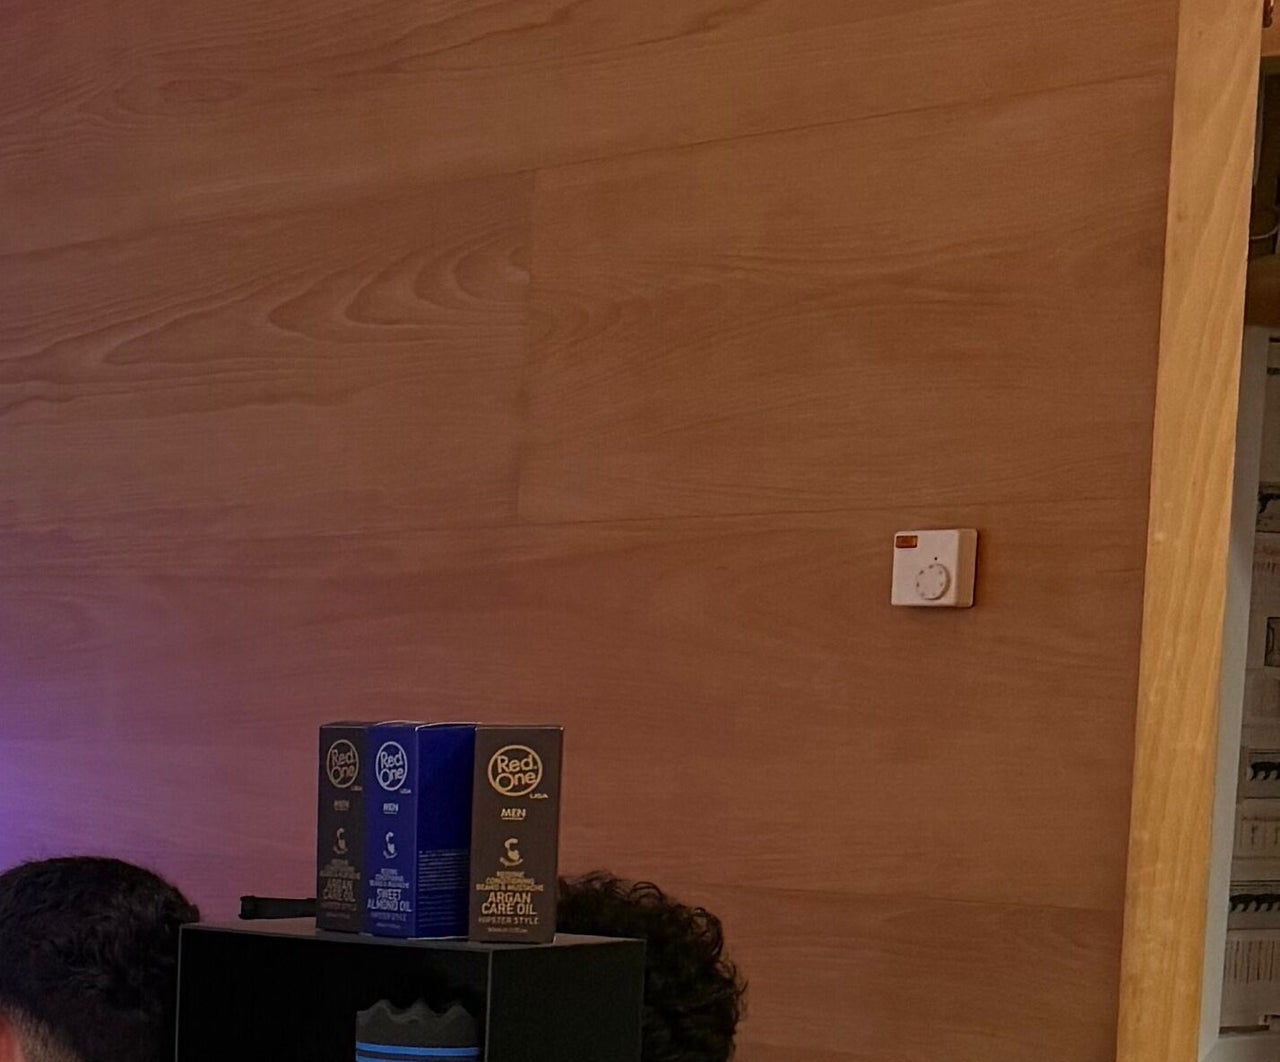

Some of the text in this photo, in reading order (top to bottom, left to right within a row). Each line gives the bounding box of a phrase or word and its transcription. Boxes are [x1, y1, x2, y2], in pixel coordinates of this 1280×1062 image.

[331, 748, 355, 767] Red
[380, 751, 404, 769] Red
[496, 753, 534, 774] Red
[331, 765, 355, 785] One
[380, 767, 404, 787] One
[495, 772, 537, 792] One
[500, 807, 527, 818] MEN
[487, 891, 532, 905] ARGAN
[481, 902, 538, 916] CARE OIL
